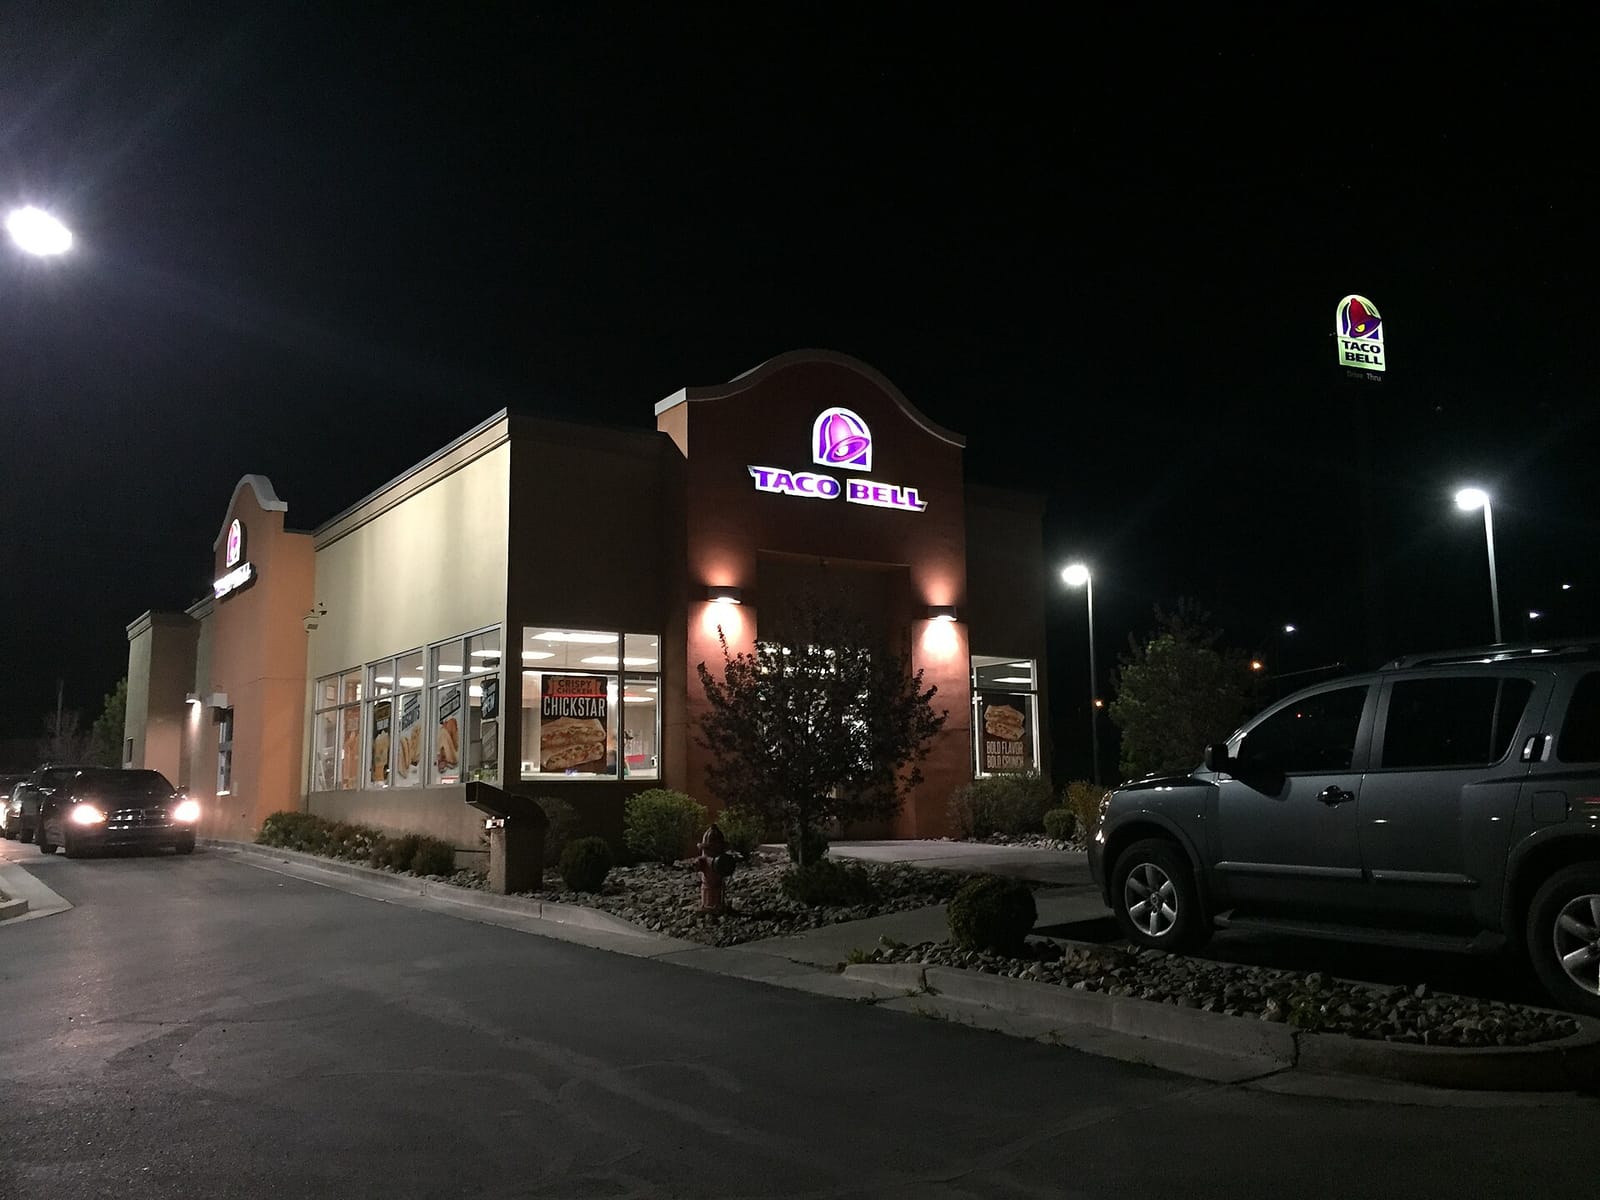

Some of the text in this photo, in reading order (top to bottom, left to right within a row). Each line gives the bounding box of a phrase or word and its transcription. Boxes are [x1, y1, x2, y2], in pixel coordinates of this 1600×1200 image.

[1341, 340, 1381, 354] TACO
[1345, 352, 1383, 365] BELL
[750, 468, 927, 508] TACO BELL
[558, 680, 592, 688] CRISPY
[543, 696, 606, 717] CHICKSTAR
[986, 741, 1024, 755] BOLD FLAVOR
[986, 755, 1001, 769] BOLD
